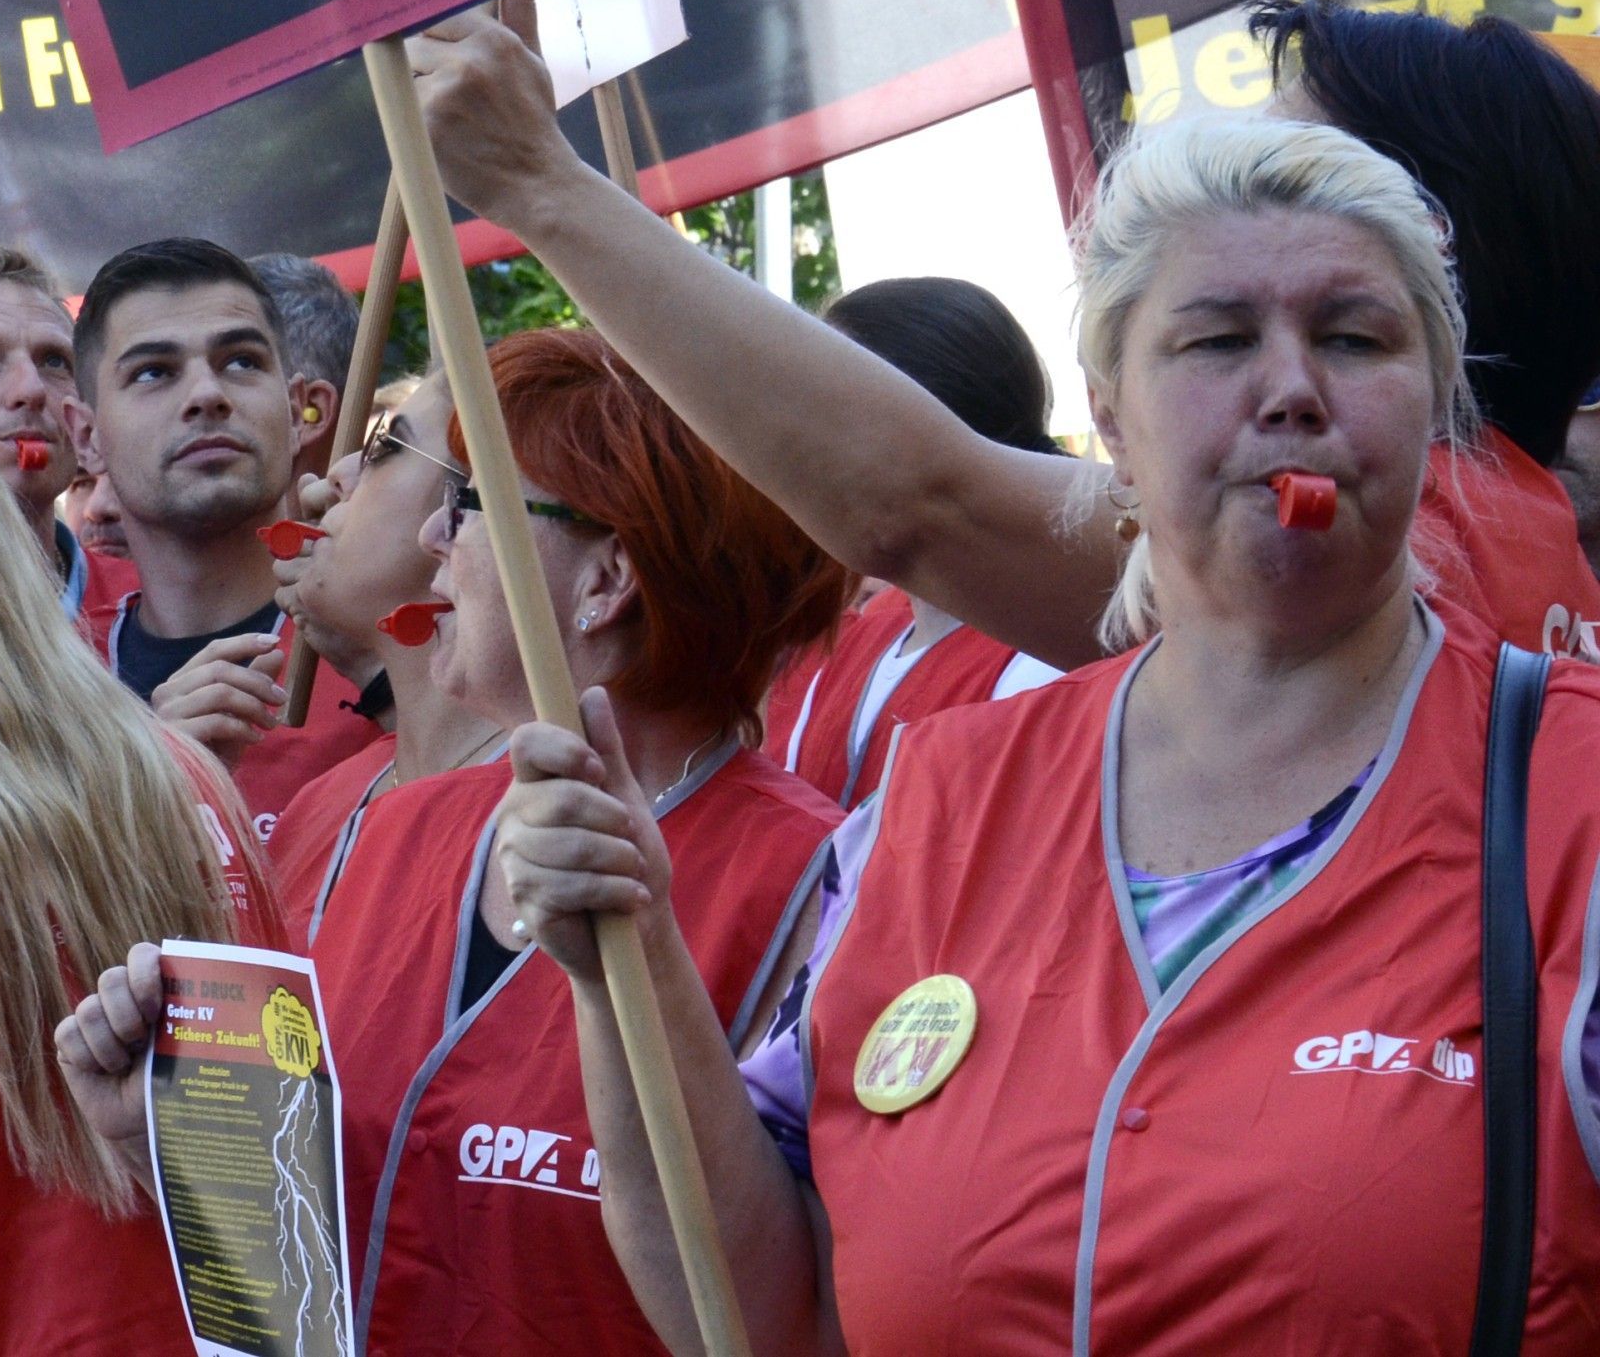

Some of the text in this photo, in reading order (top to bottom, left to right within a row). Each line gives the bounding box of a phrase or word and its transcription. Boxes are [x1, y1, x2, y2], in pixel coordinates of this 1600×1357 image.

[197, 1006, 214, 1021] KV
[173, 1026, 261, 1048] Sichere Zukunft!
[1293, 1030, 1420, 1070] GPA
[459, 1124, 572, 1184] GPA
